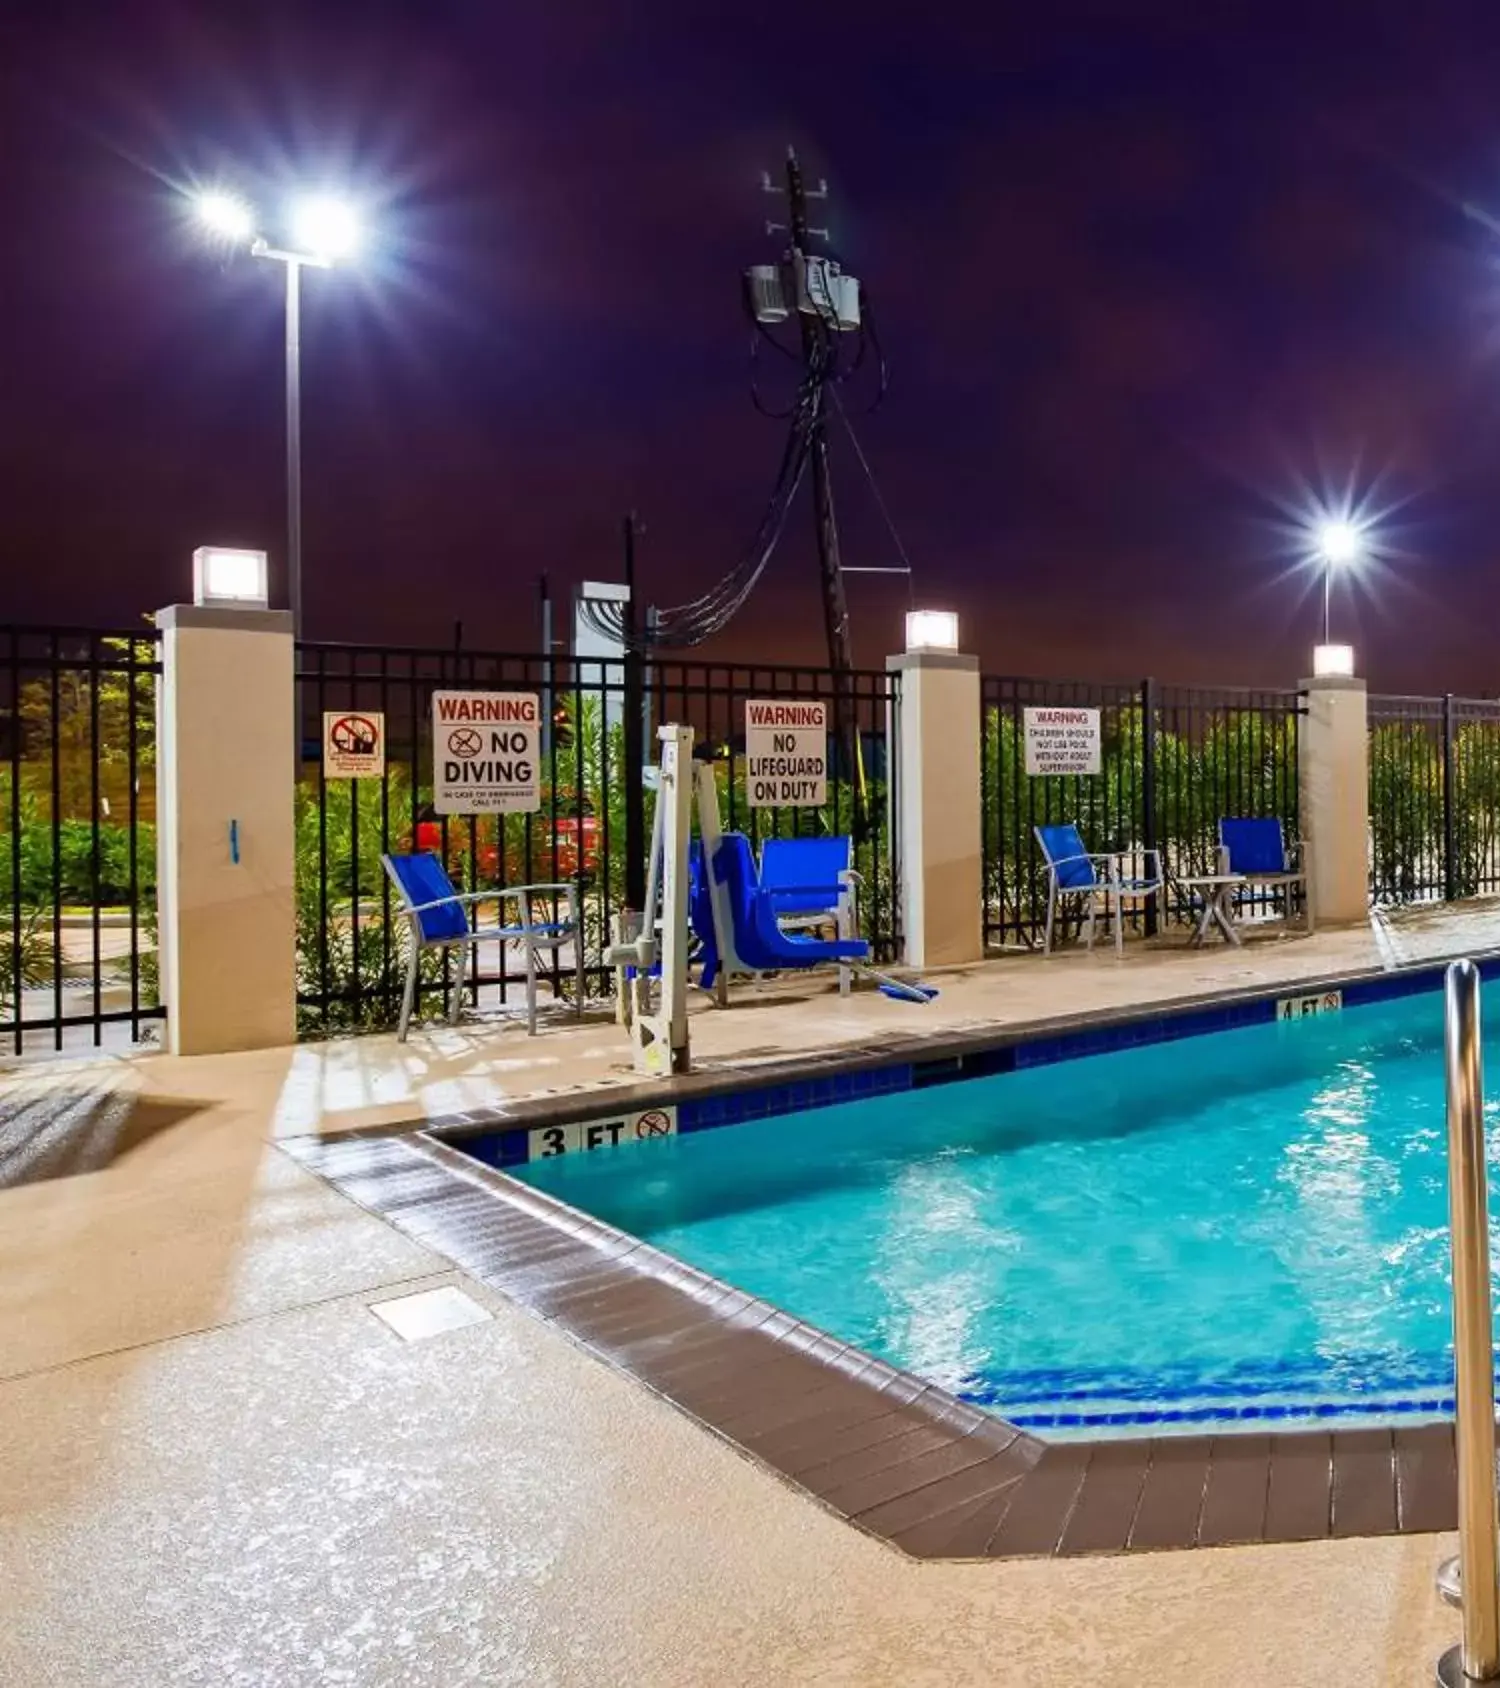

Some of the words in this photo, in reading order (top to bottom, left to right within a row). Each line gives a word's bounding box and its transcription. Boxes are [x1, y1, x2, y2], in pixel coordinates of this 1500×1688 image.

[438, 698, 535, 721] WARNING
[749, 705, 823, 725] WARNING
[1035, 711, 1089, 724] WARNING
[491, 732, 528, 754] NO
[773, 734, 796, 753] NO
[445, 761, 532, 783] DIVING
[749, 757, 824, 777] LIFEGUARD
[755, 781, 777, 800] ON
[781, 781, 817, 800] DUTY
[541, 1128, 566, 1157] 3
[587, 1121, 625, 1150] FT
